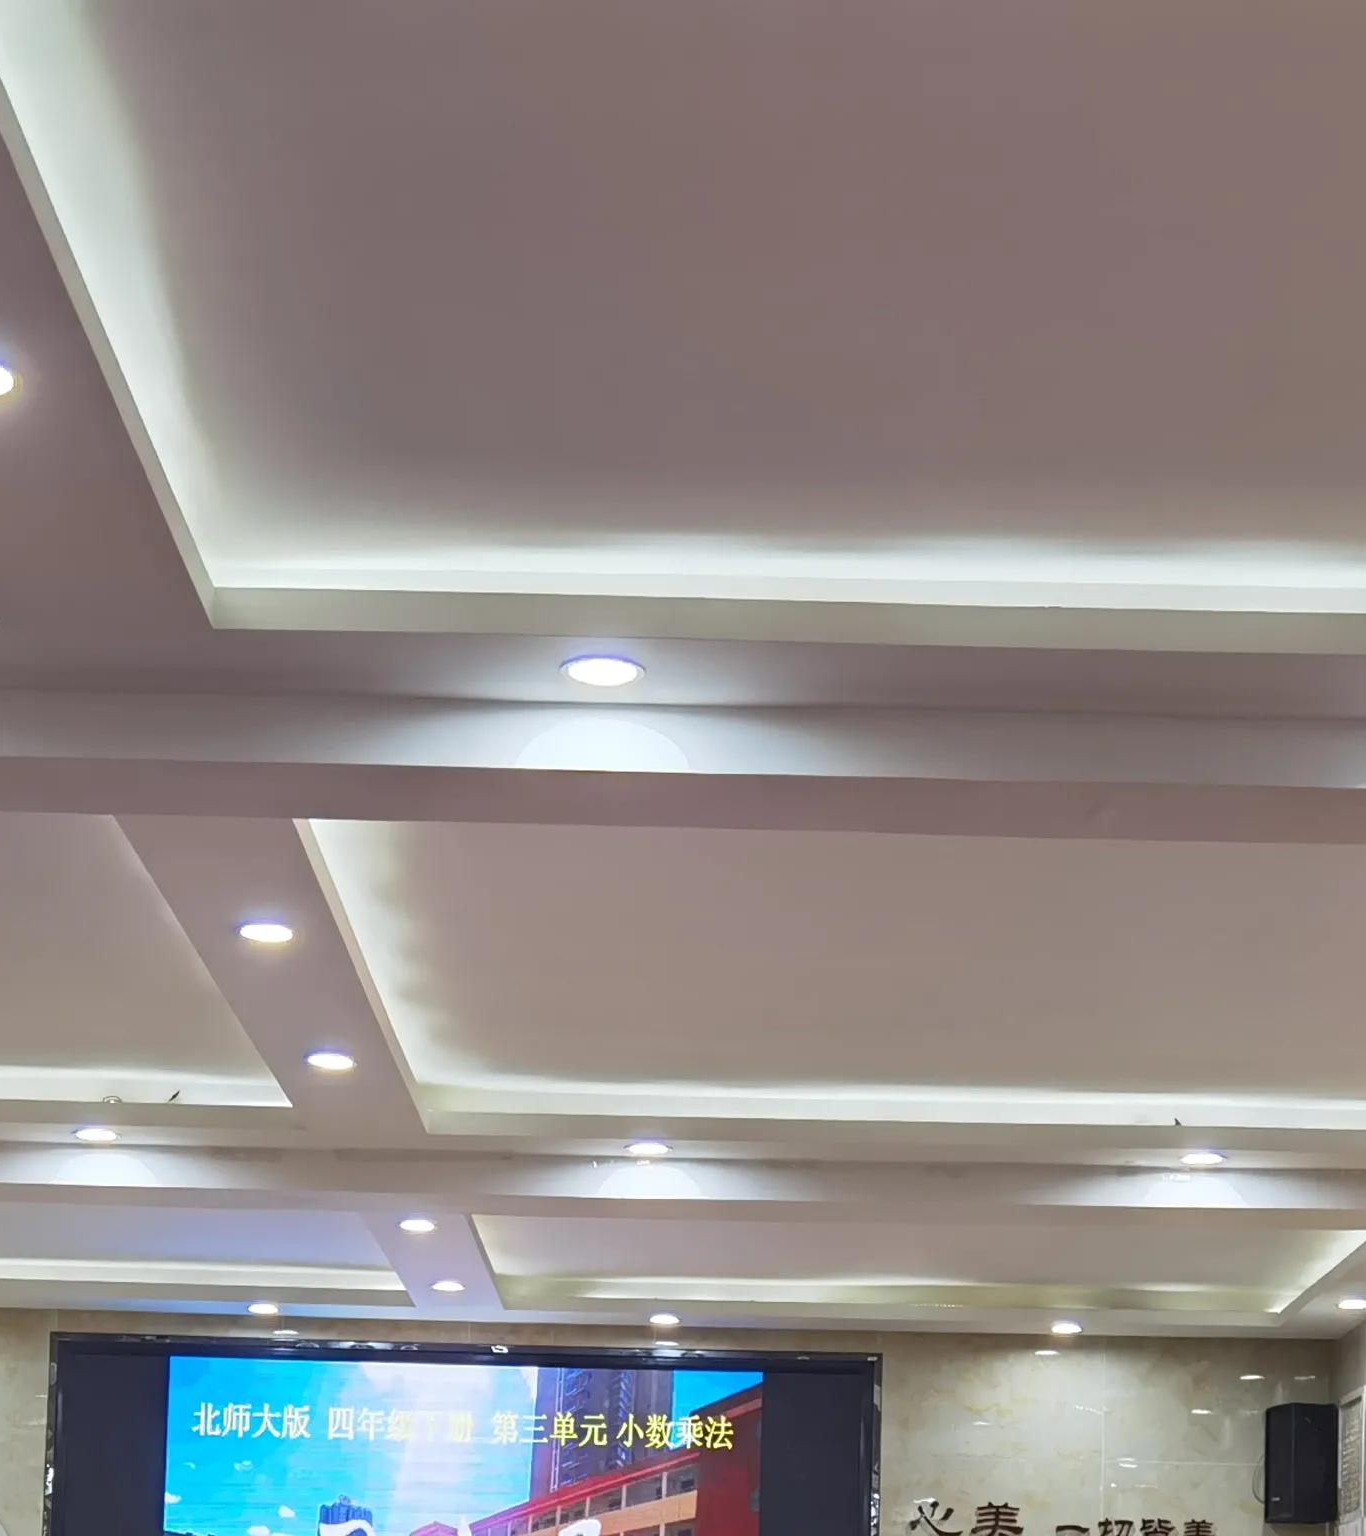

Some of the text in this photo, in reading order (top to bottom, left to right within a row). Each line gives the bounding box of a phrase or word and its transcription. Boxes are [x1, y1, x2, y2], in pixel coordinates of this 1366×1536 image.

[191, 1402, 311, 1440] 北师大版
[492, 1411, 608, 1448] 第三单元
[616, 1414, 734, 1450] 小数乘法
